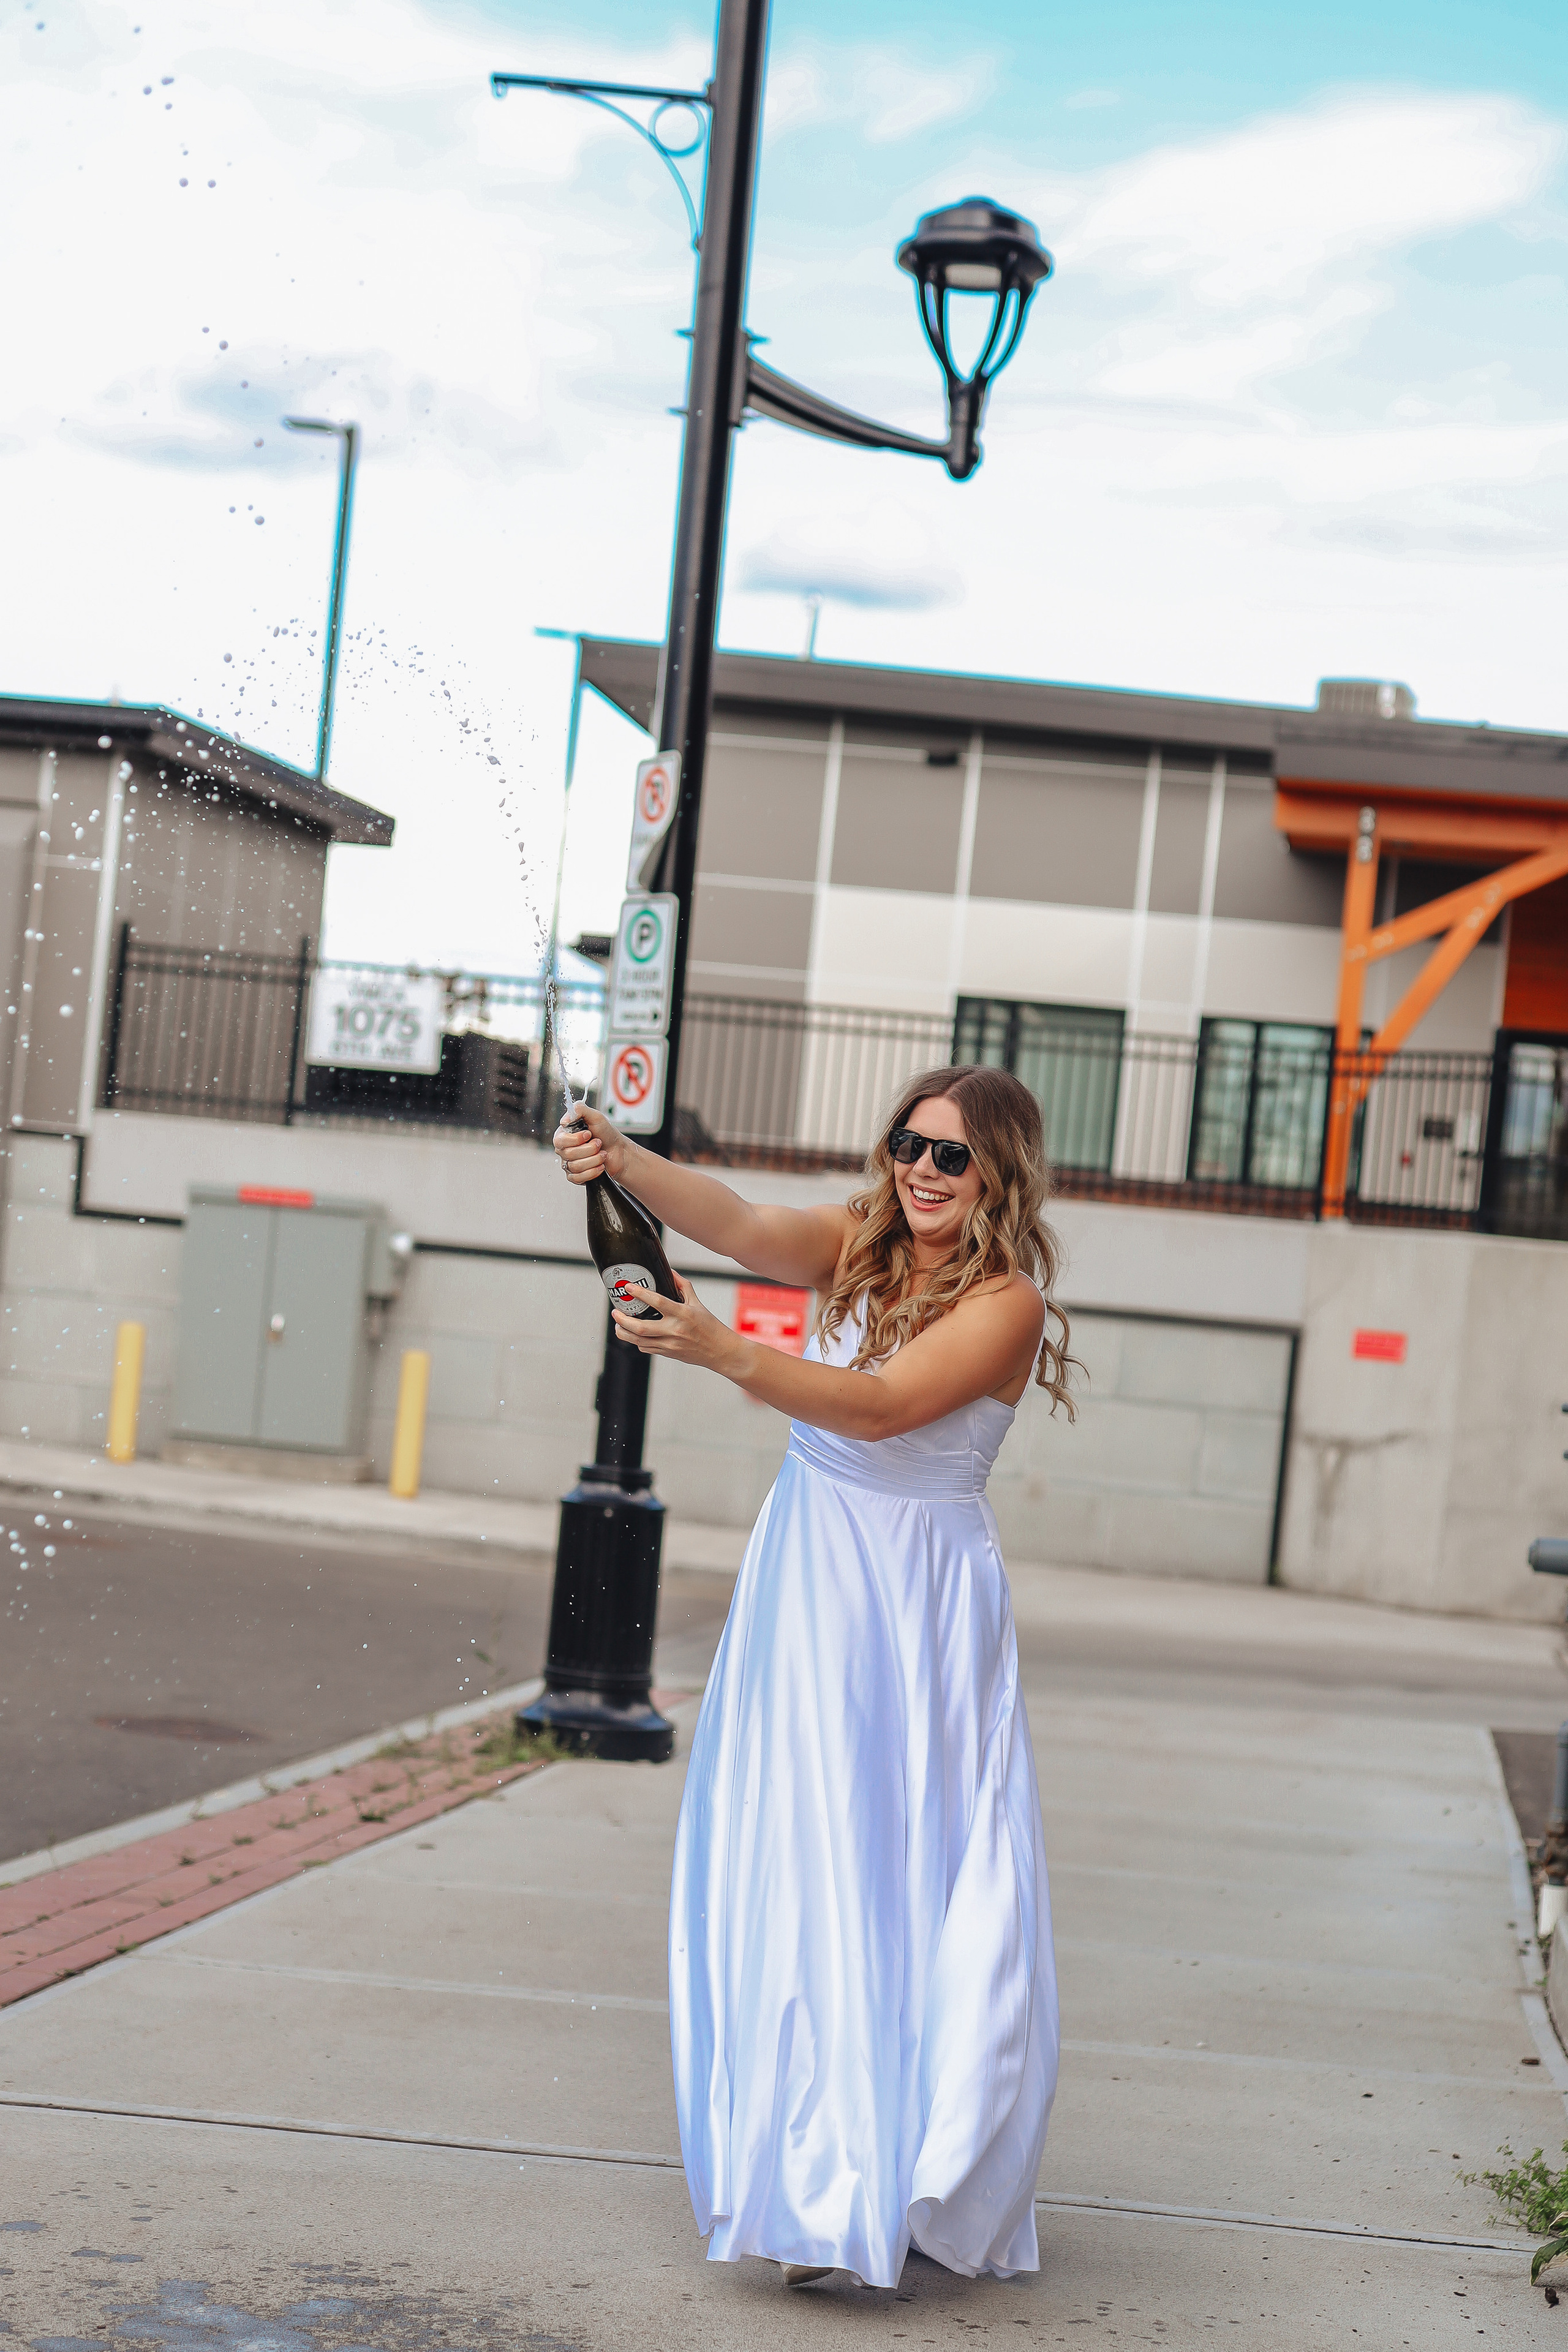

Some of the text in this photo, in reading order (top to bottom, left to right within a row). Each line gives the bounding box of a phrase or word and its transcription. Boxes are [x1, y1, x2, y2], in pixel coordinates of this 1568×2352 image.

[636, 921, 656, 949] P
[334, 1003, 421, 1041] 1075
[608, 1279, 647, 1297] MARI
